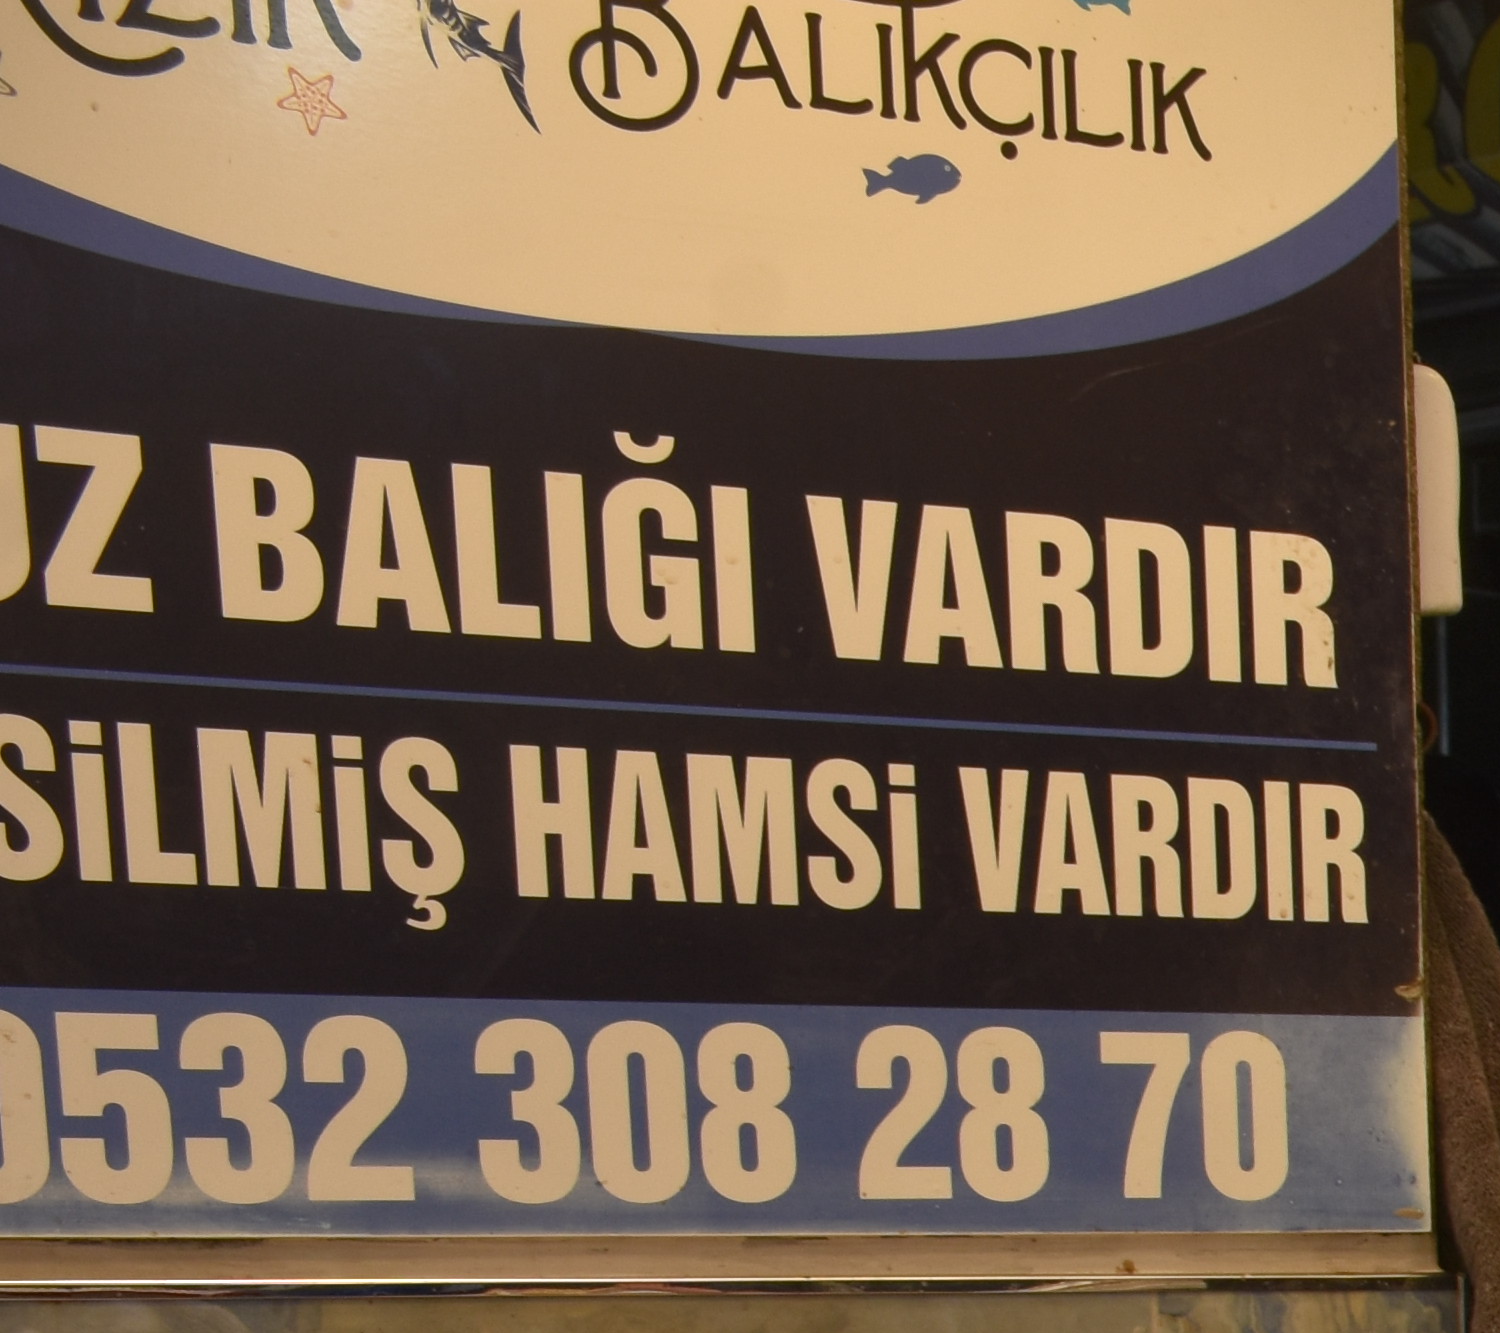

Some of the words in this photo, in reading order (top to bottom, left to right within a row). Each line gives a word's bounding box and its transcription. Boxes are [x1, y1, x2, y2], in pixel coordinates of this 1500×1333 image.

[0, 424, 154, 613] Z
[209, 431, 756, 654] BALIĞI
[805, 494, 1338, 689] VARDIR
[959, 766, 1369, 924] VARDIR
[474, 1018, 799, 1205] 308
[856, 1024, 1050, 1203] 28
[1099, 1030, 1289, 1202] 70
